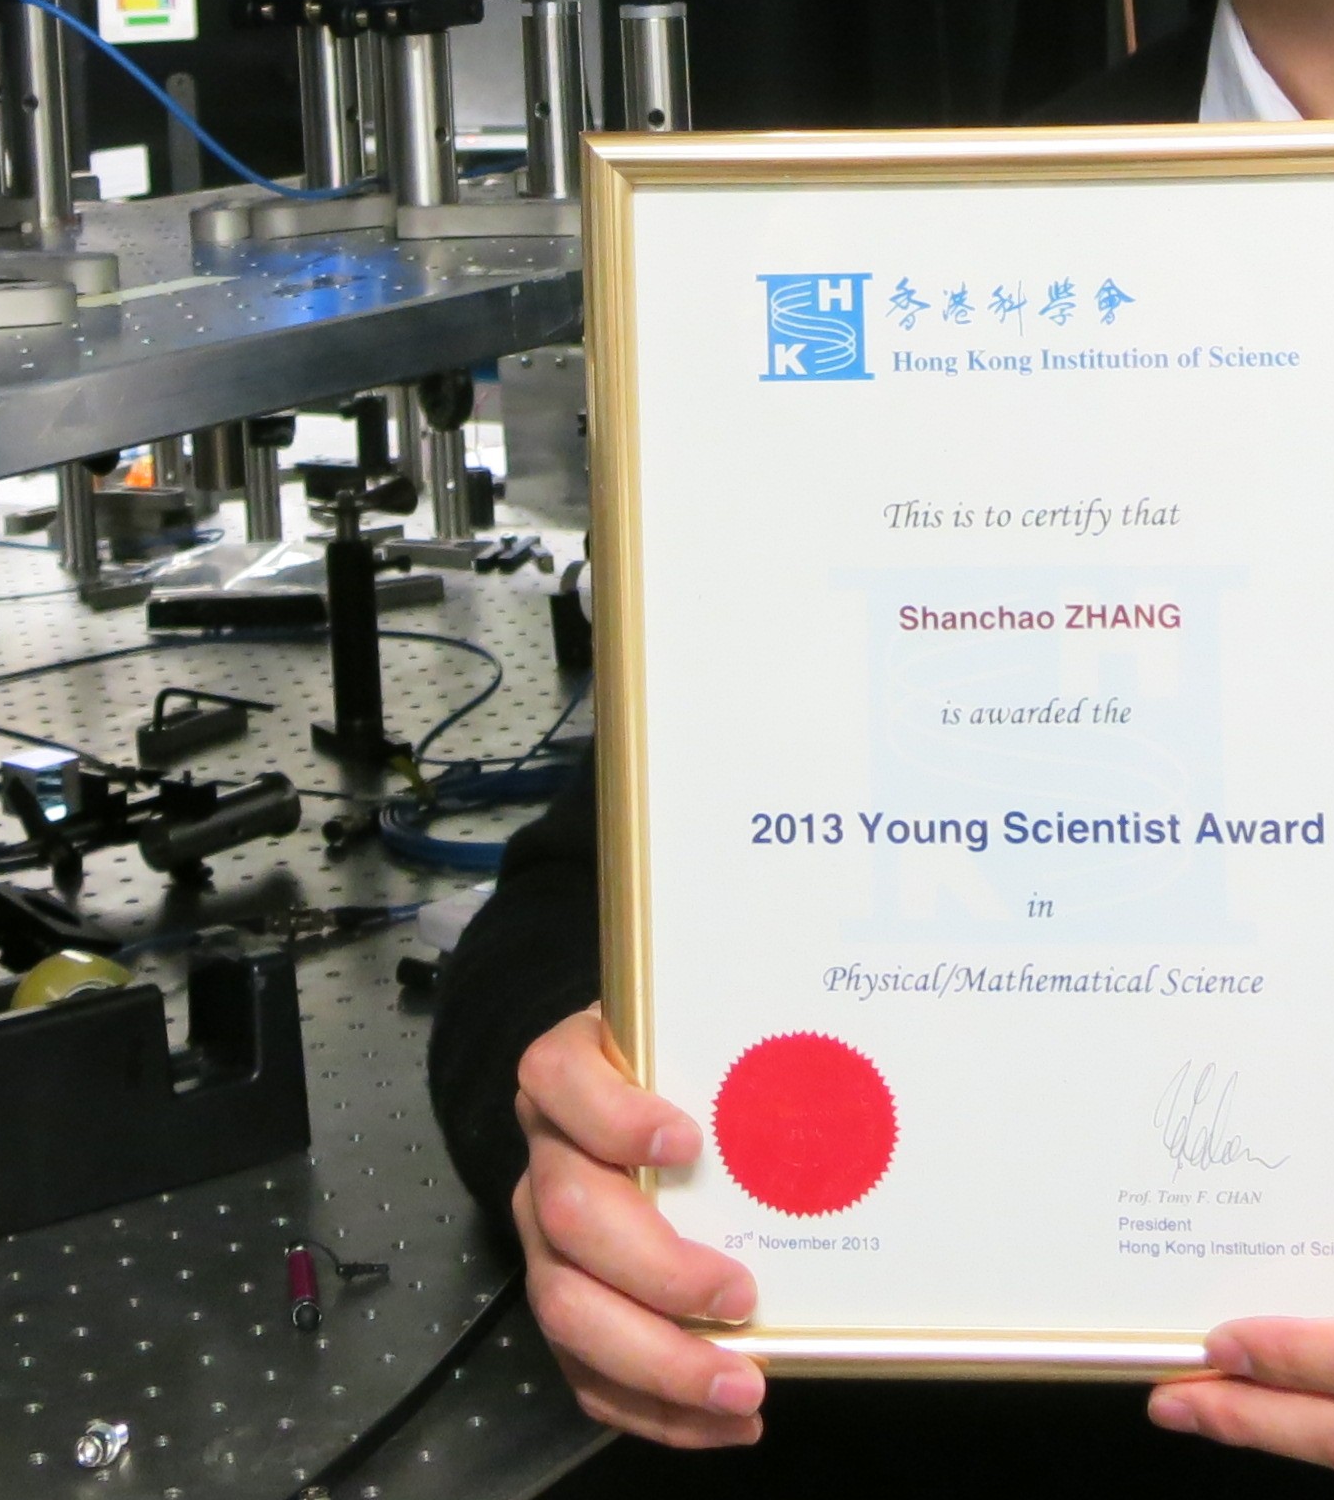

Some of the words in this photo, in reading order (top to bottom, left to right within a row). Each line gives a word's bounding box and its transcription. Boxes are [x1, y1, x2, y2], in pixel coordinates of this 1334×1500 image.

[885, 275, 1137, 337] 香港科學會
[893, 351, 959, 376] Hong
[966, 350, 1033, 376] Kong
[1041, 347, 1169, 370] Institution
[1177, 346, 1203, 369] of
[1208, 345, 1300, 368] Science
[883, 499, 944, 529] This
[952, 501, 975, 528] is
[985, 506, 1012, 528] to
[1021, 497, 1112, 537] certify
[1121, 496, 1180, 527] that
[899, 604, 1055, 631] Shanchao
[1065, 603, 1181, 630] ZHANG
[941, 700, 962, 725] is
[969, 697, 1083, 725] awarded
[1092, 696, 1132, 725] the
[751, 812, 844, 845] 2013
[858, 811, 989, 853] Young
[1003, 810, 1181, 845] Scientist
[1194, 812, 1325, 845] Award
[1026, 891, 1054, 918] in
[823, 963, 1155, 1002] Physical/Mathematical
[1161, 965, 1264, 997] Science
[1117, 1189, 1152, 1206] Prof.
[1158, 1190, 1192, 1208] Tony
[1196, 1190, 1211, 1205] F.
[1215, 1190, 1263, 1205] CHAN
[1118, 1216, 1192, 1232] President
[758, 1234, 838, 1252] November
[841, 1235, 881, 1252] 2013
[1118, 1240, 1160, 1258] Hong
[1164, 1240, 1205, 1259] Kong
[1210, 1241, 1286, 1257] Institution
[1290, 1241, 1306, 1257] of
